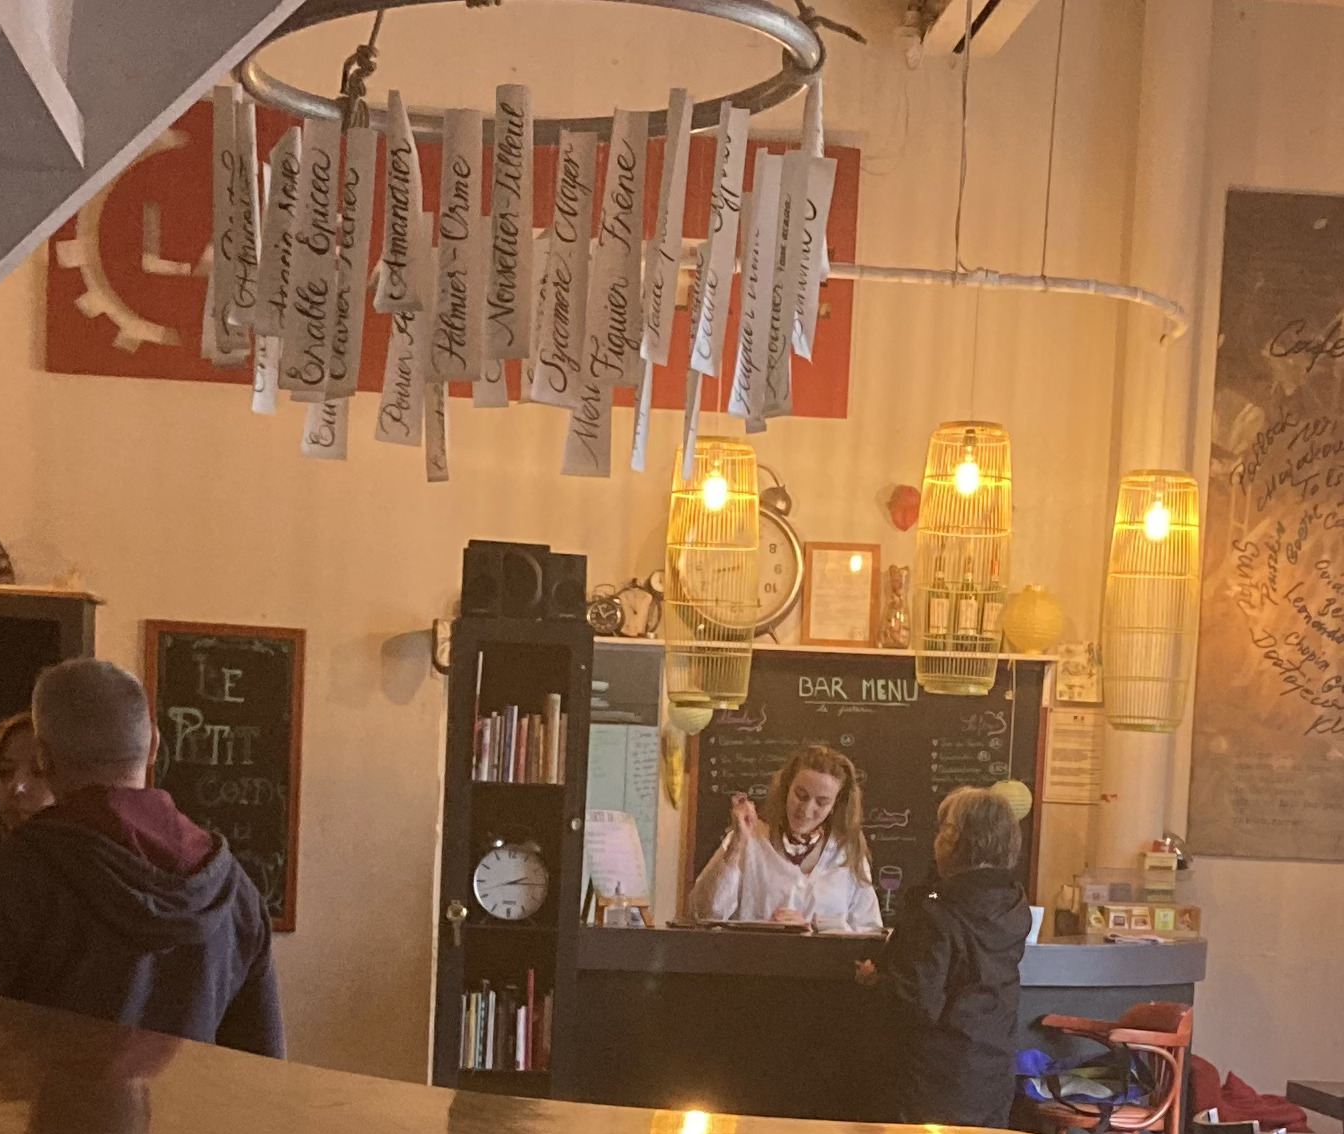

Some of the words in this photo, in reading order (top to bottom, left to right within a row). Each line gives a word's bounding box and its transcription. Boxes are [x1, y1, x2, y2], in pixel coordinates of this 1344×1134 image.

[383, 137, 412, 299] Amandier
[440, 155, 471, 241] Orme
[599, 139, 636, 253] Frêne
[432, 267, 468, 373] Palmier
[589, 276, 640, 380] Figuier
[798, 676, 848, 700] BAR
[861, 677, 919, 702] MENU
